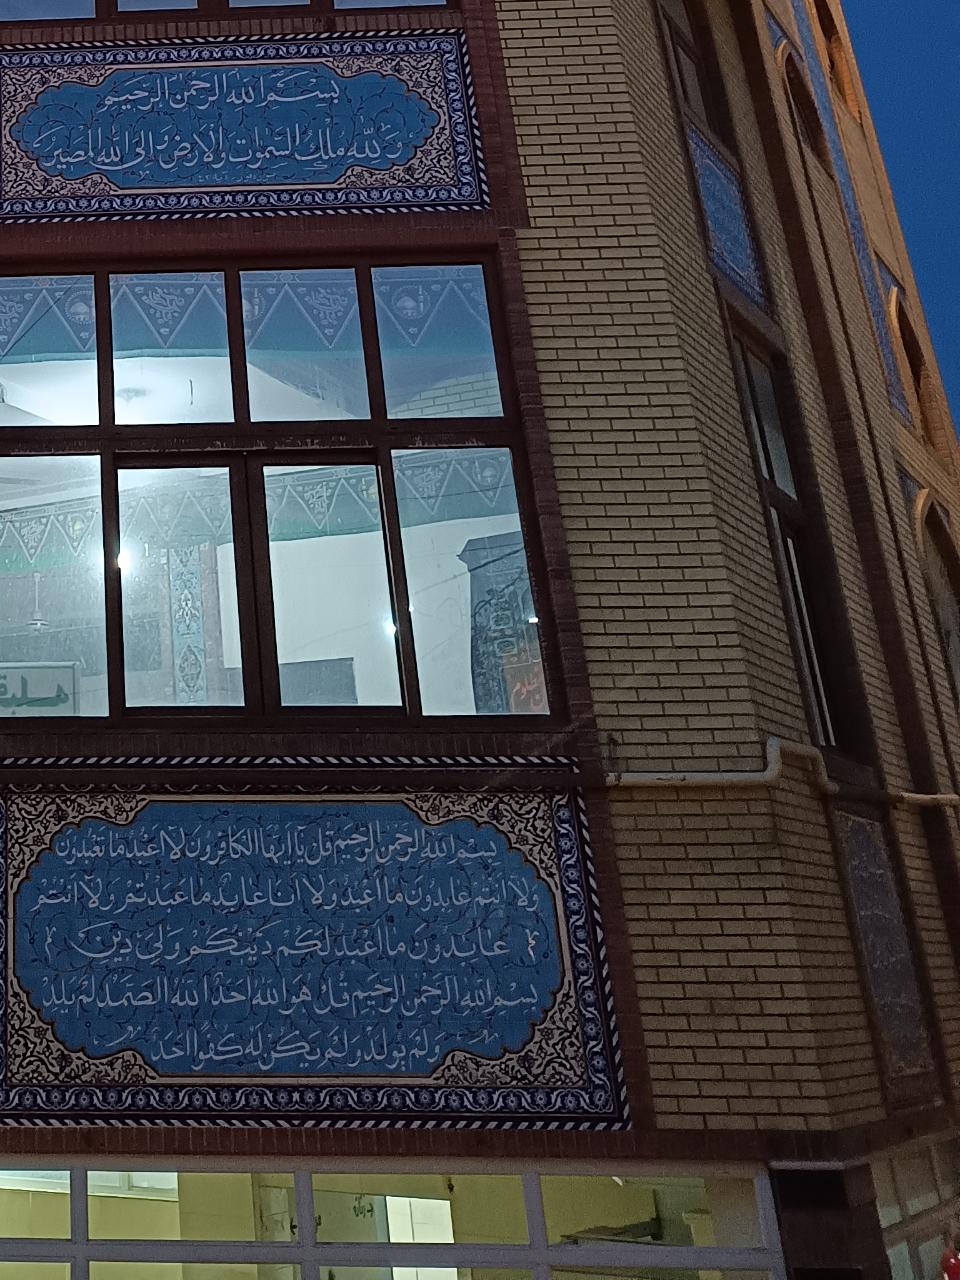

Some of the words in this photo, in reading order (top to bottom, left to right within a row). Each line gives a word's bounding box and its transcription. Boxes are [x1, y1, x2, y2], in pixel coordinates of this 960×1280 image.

[96, 75, 170, 113] الرحيم
[169, 72, 227, 111] الرحمن
[226, 74, 266, 108] الله
[256, 70, 341, 109] بسم
